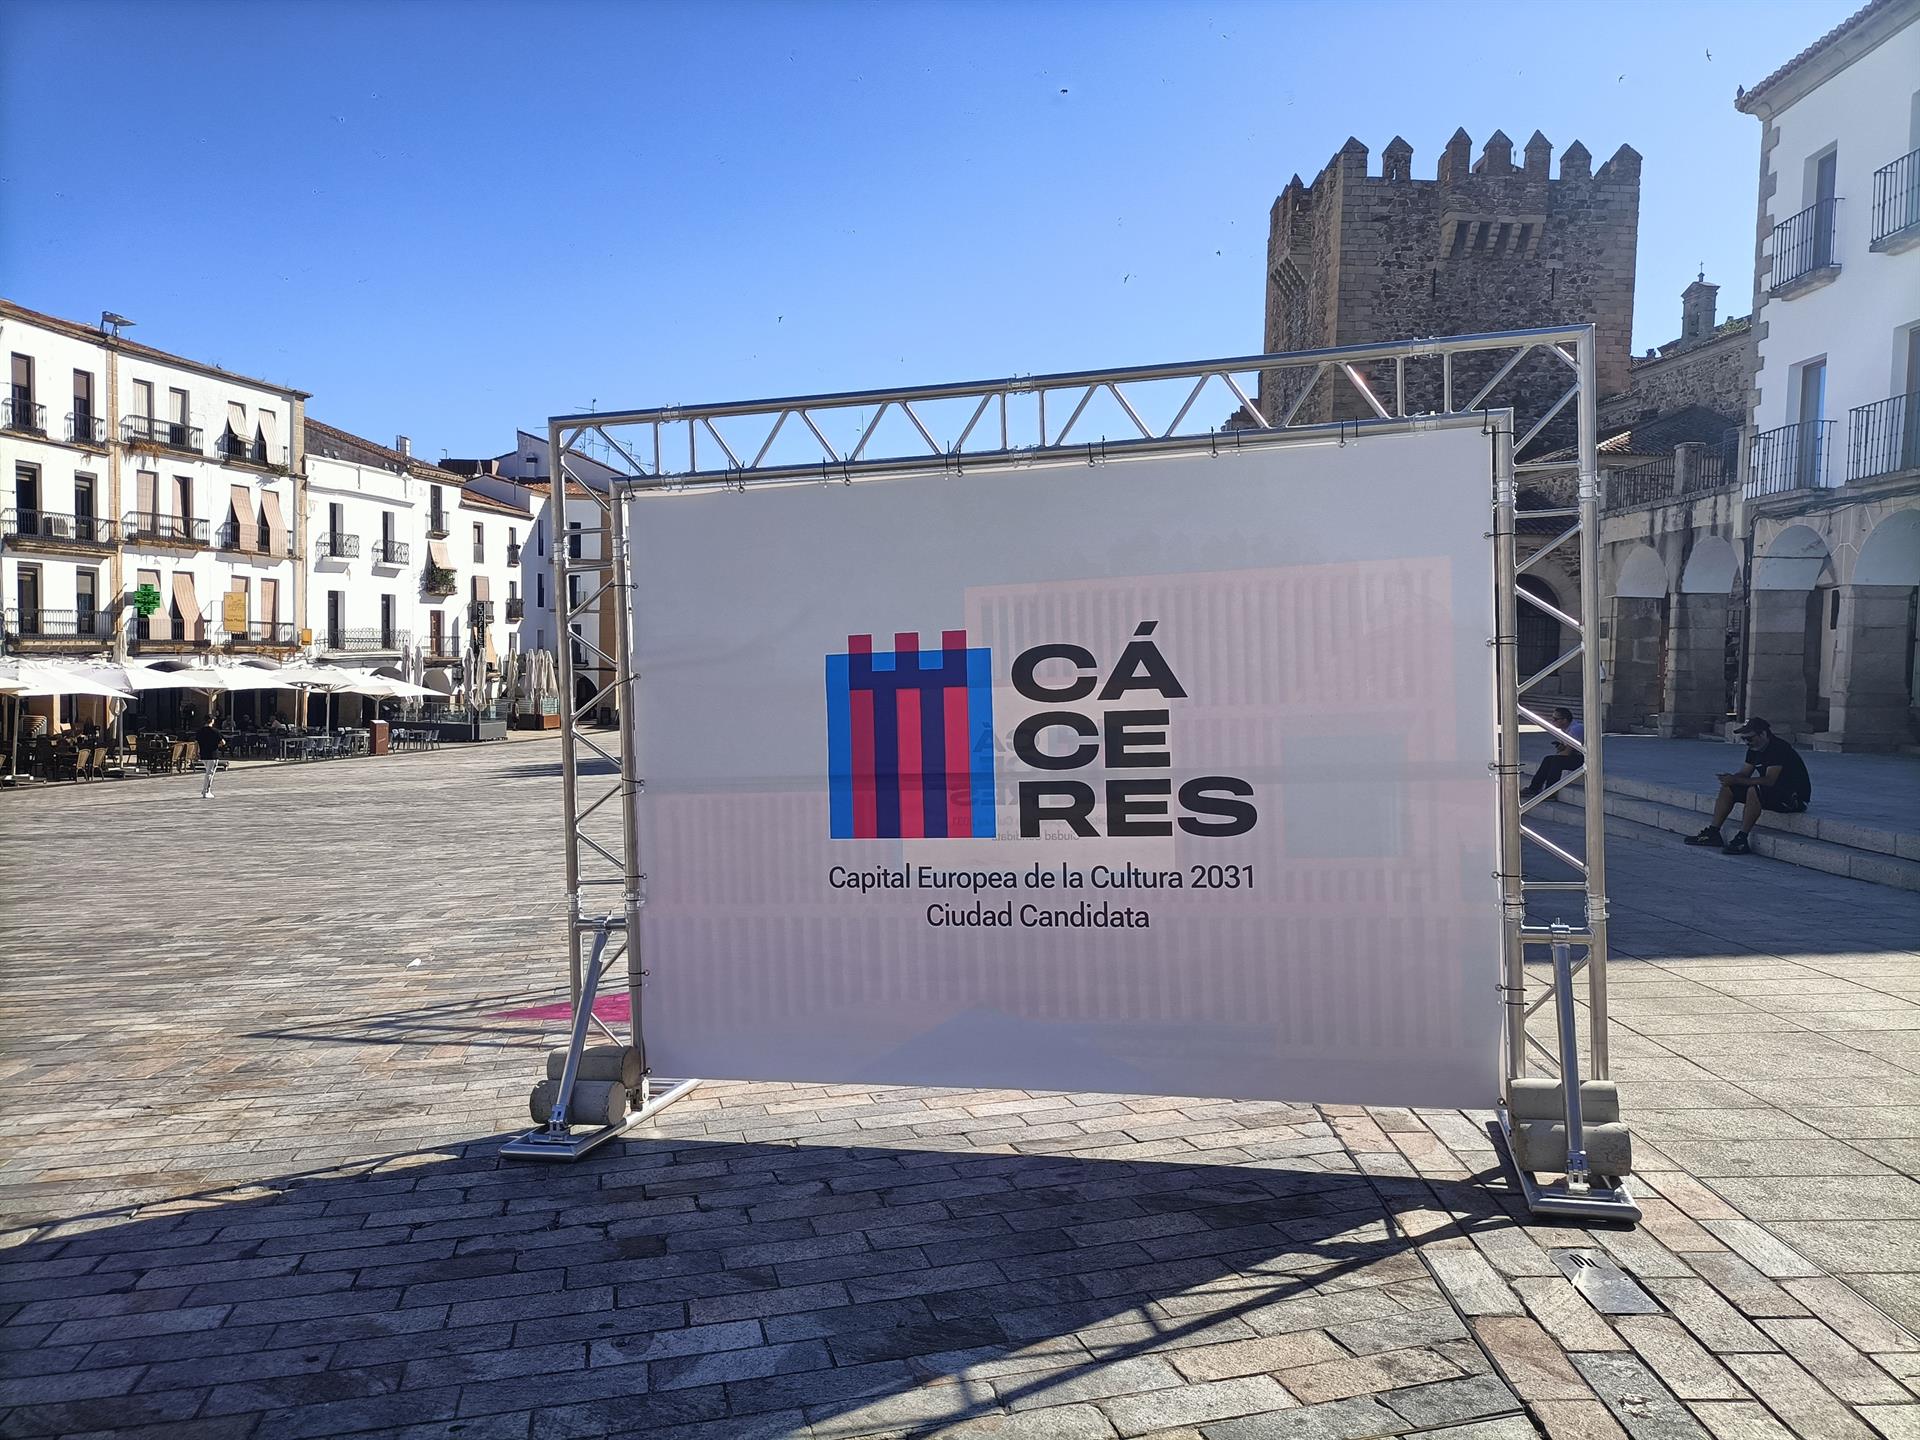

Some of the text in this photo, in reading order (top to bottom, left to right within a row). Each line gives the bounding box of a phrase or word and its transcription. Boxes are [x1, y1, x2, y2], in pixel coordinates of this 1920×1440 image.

[1012, 621, 1188, 702] CÁ
[1013, 710, 1170, 770] CE
[1019, 776, 1257, 837] RES
[830, 862, 1253, 894] Capital Europea de la Cultura 2031
[927, 901, 1149, 928] Ciudad Candidata
